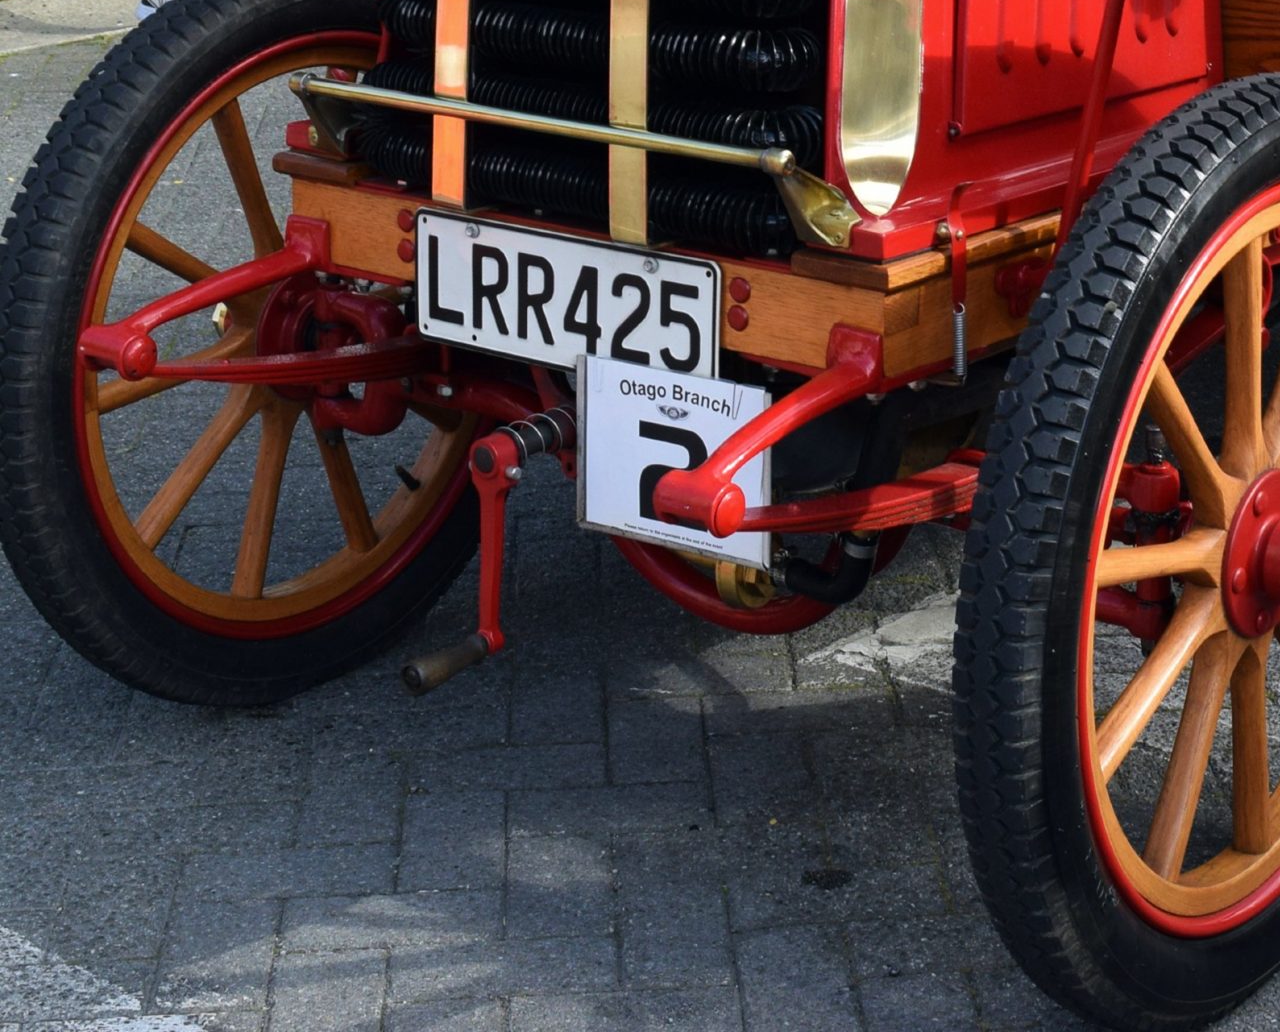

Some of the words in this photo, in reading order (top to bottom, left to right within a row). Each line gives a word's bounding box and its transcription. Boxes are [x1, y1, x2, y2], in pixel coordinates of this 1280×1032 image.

[428, 235, 701, 373] LRR425
[619, 379, 667, 400] Otago
[672, 384, 731, 417] Branch
[639, 420, 709, 533] 2
